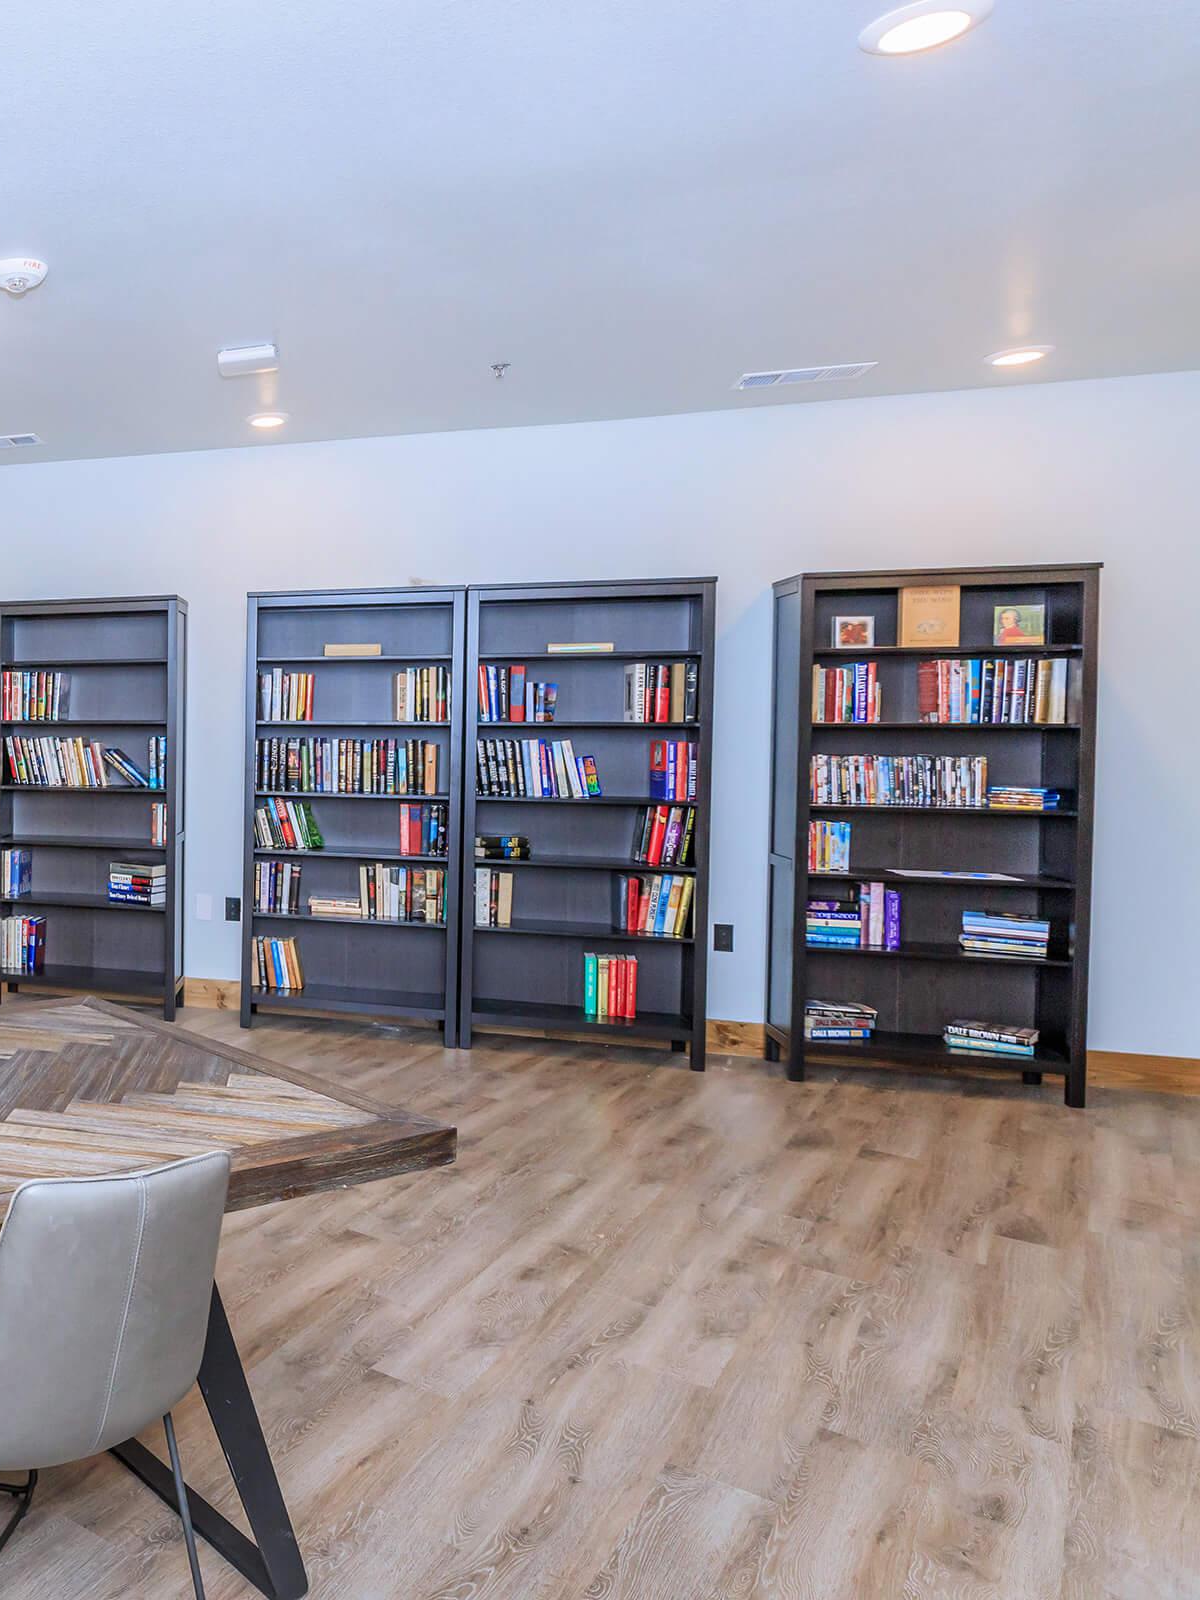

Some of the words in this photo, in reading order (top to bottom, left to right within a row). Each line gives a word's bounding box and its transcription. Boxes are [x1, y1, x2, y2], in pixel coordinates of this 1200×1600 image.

[812, 1029, 827, 1037] DALE
[828, 1029, 850, 1037] BROWN
[947, 1026, 968, 1035] DALE
[969, 1030, 1000, 1041] BROWN
